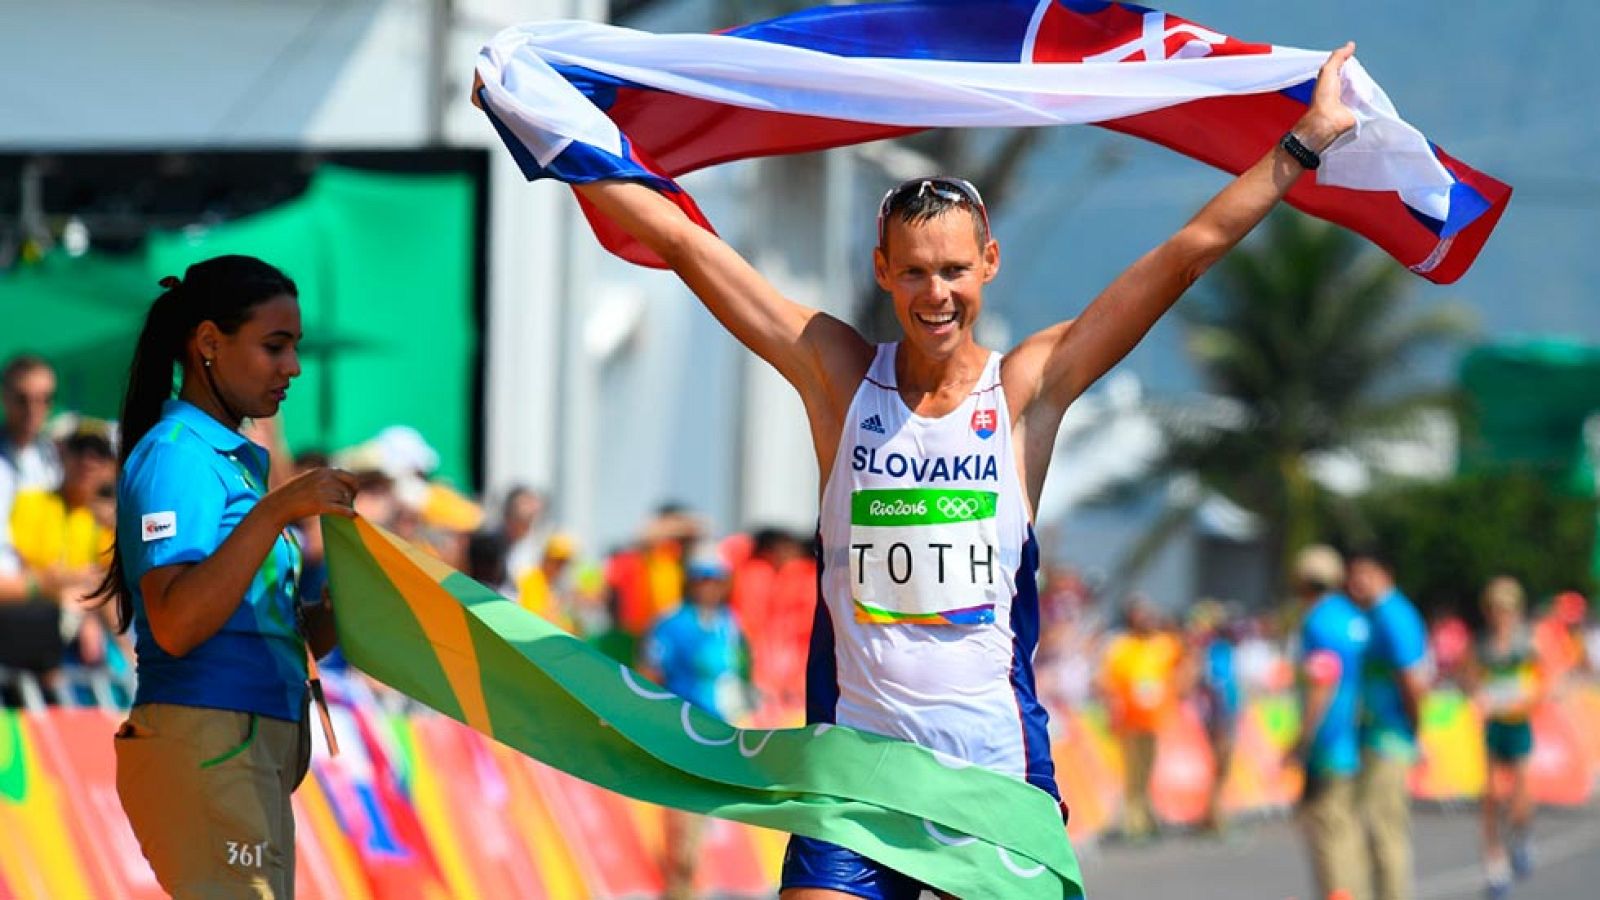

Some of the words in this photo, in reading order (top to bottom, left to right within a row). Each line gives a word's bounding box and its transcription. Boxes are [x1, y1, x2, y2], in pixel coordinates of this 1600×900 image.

[851, 445, 998, 482] SLOVAKIA
[869, 499, 928, 516] Rio2016
[851, 542, 994, 584] TOTH
